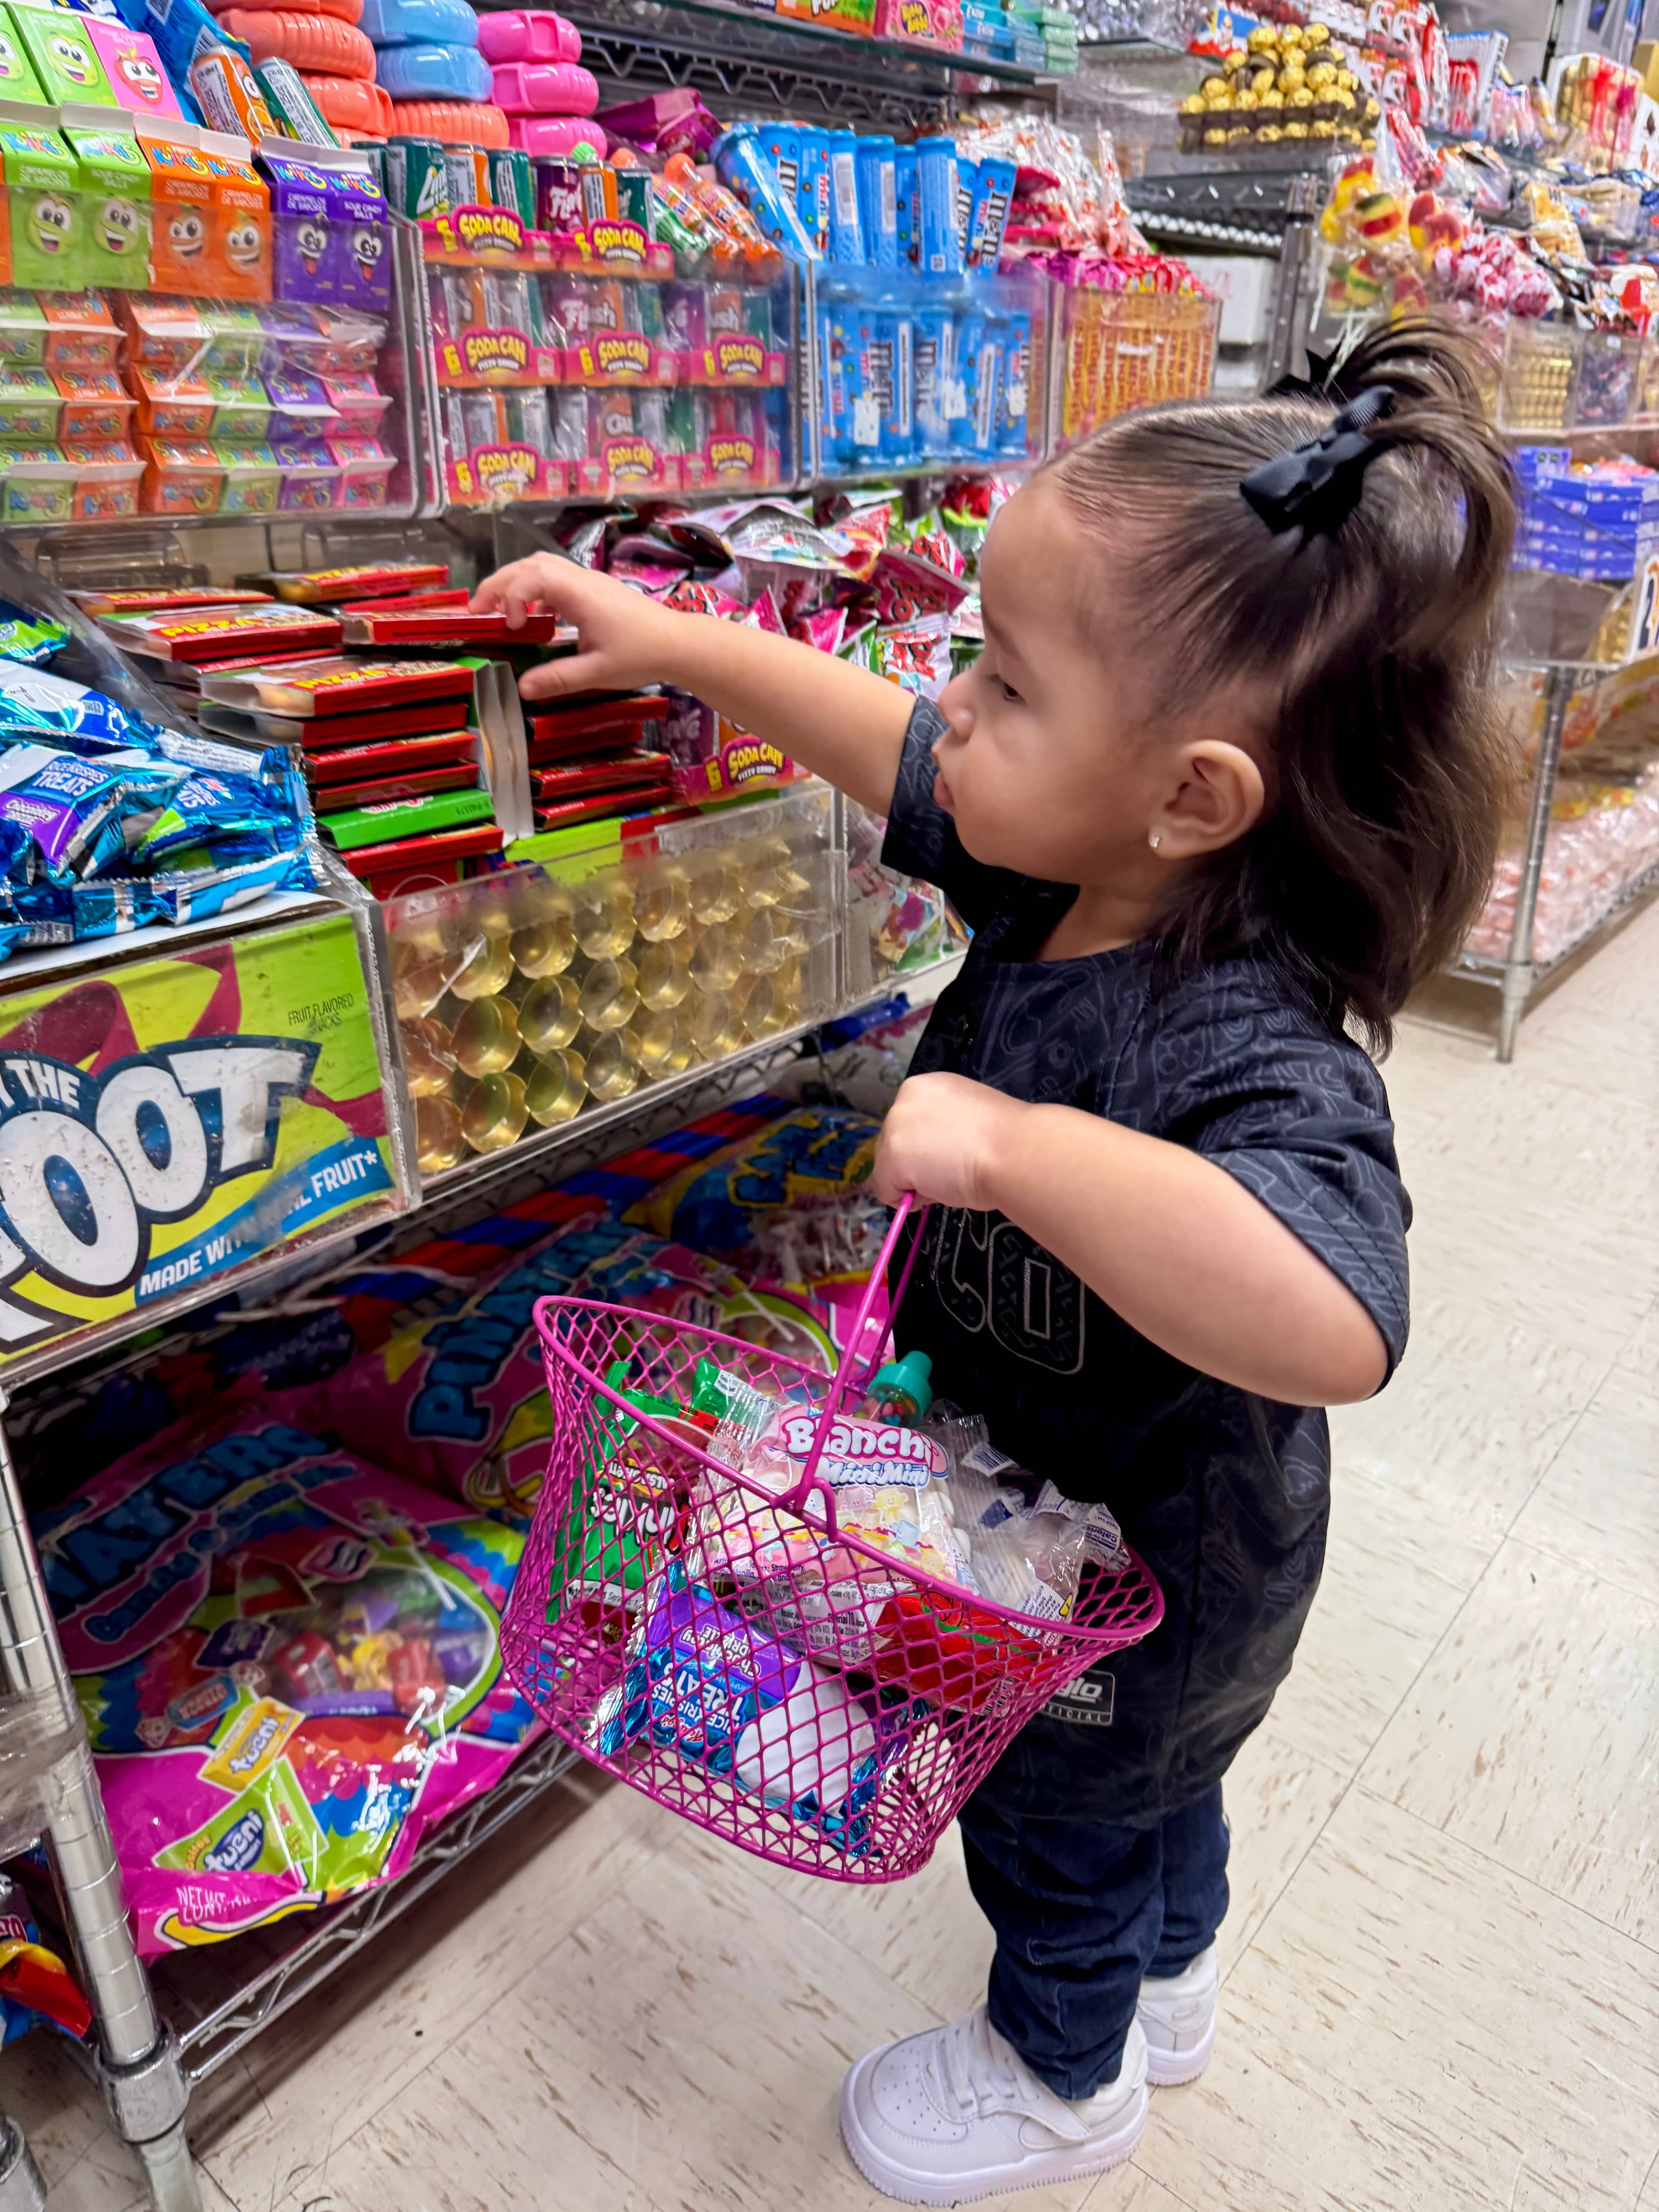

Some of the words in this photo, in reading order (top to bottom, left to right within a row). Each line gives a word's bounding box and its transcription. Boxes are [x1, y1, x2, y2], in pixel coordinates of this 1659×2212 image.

[460, 214, 492, 246] SODA
[493, 213, 521, 247] CAN
[594, 228, 620, 255] SODA
[622, 228, 646, 257] CAN
[466, 336, 498, 367] SODA
[500, 335, 526, 366] CAN
[599, 340, 626, 368] SODA
[627, 340, 648, 370] CAN
[728, 746, 759, 778] SODA
[760, 744, 783, 768] CAN
[33, 771, 93, 796] TREATS
[288, 1005, 311, 1025] FRUIT
[313, 993, 354, 1017] FLAVORED
[4, 1059, 80, 1108] THE
[0, 1047, 307, 1295] OOT
[140, 1250, 203, 1296] MADE
[785, 1415, 933, 1460] Banchi
[771, 1563, 805, 1573] Strawerry,
[176, 1887, 202, 1907] NET
